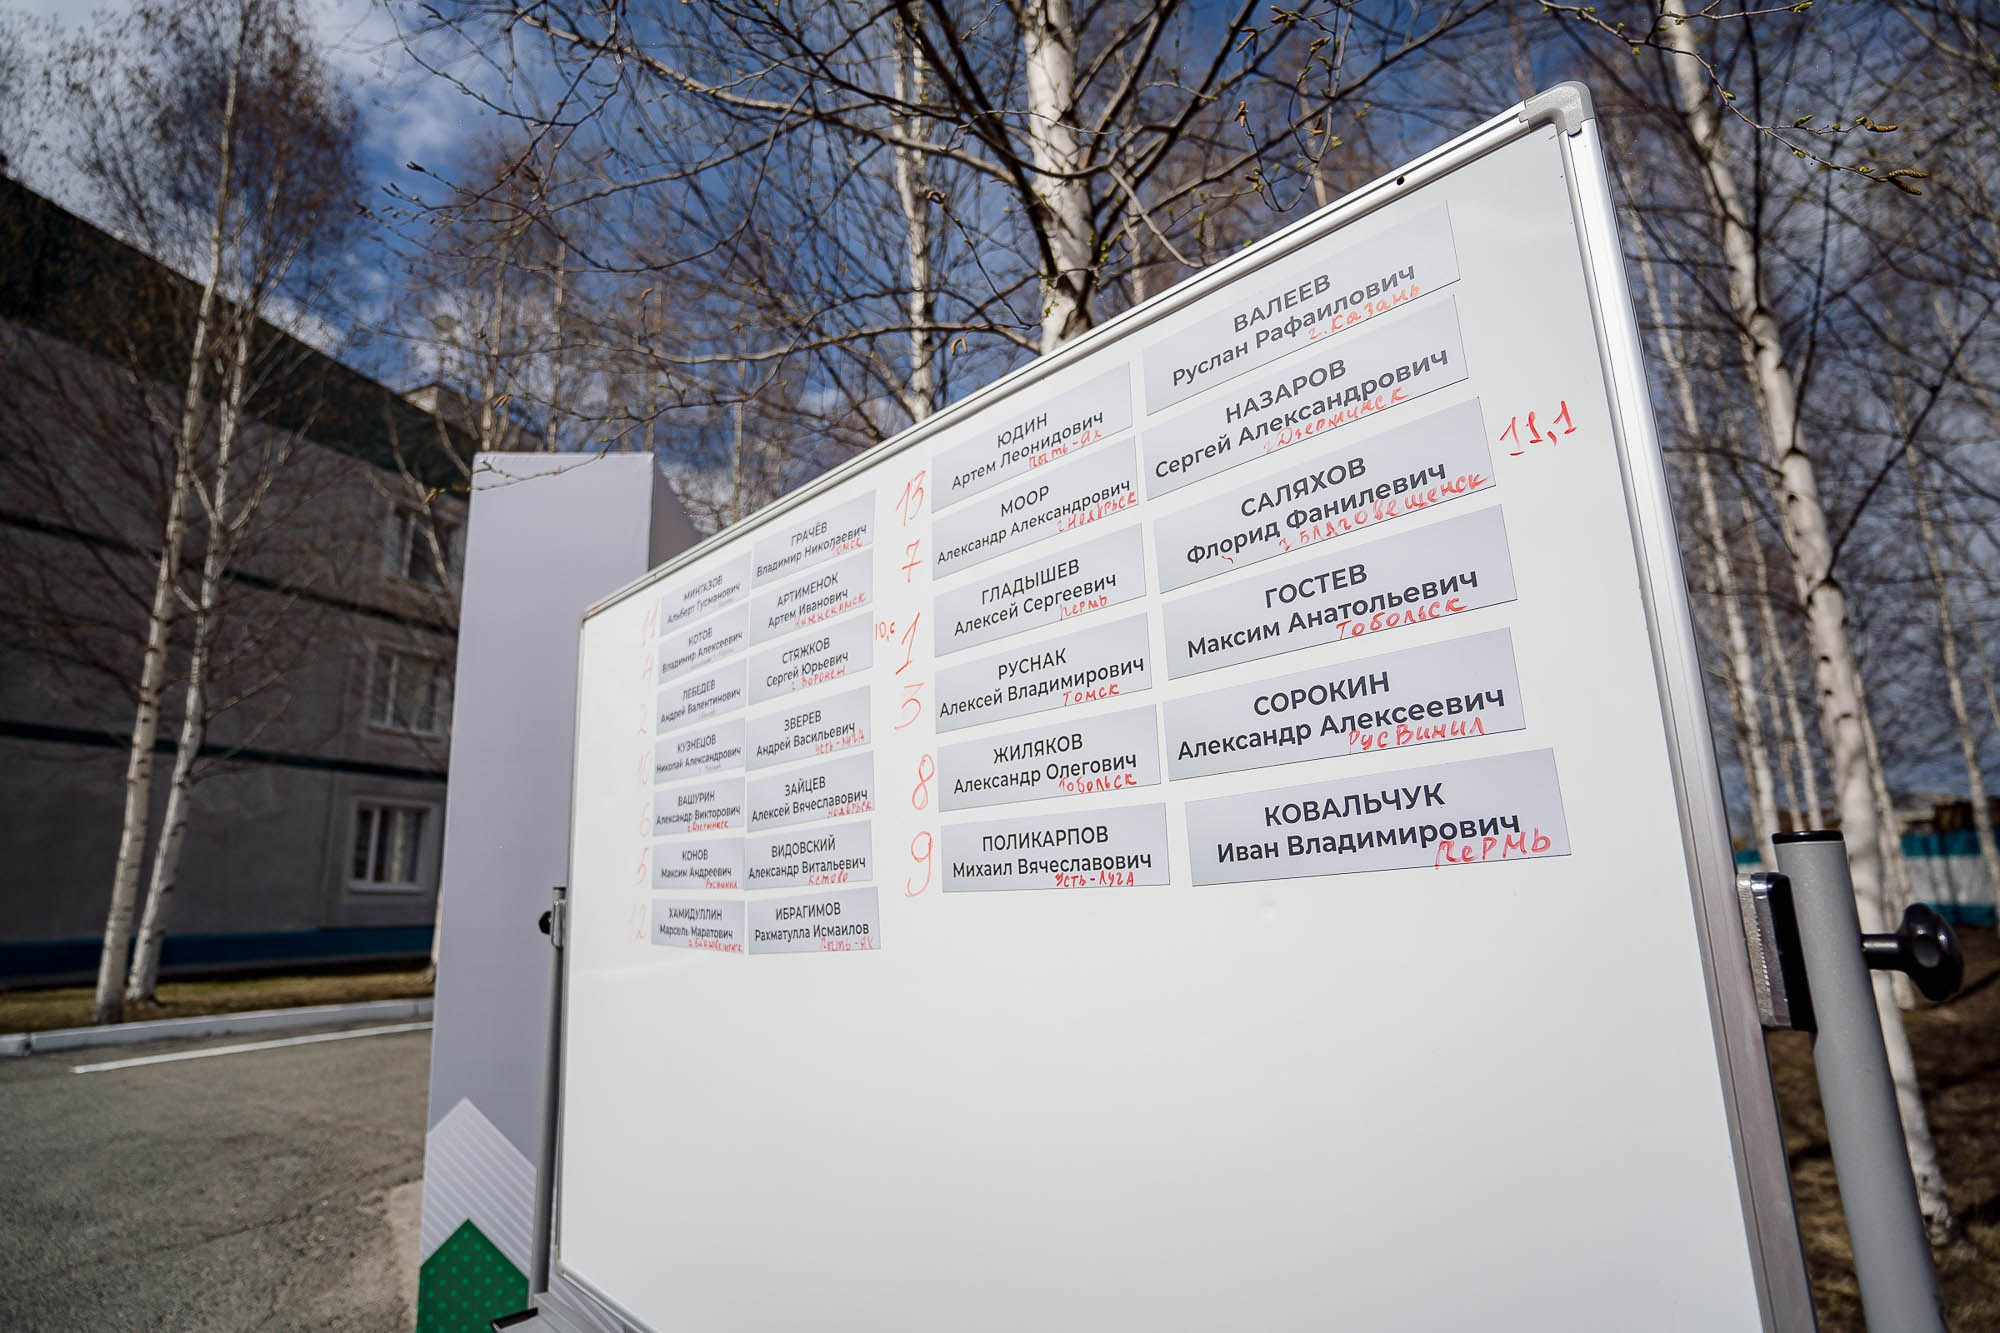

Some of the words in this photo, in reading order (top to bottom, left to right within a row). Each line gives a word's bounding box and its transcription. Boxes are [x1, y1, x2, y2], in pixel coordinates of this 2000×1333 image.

[1233, 274, 1331, 332] ВАЛЕЕВ
[1172, 341, 1248, 386] Руслан
[1255, 265, 1416, 348] Рафаилович
[1225, 358, 1347, 424] НАЗАРОВ
[997, 413, 1048, 448] ЮДИН
[1155, 436, 1231, 479] Сергей
[1238, 349, 1449, 446] Александрович
[952, 461, 996, 490] Артем
[1001, 412, 1103, 467] Леонидович
[896, 470, 927, 527] 13
[1001, 485, 1049, 517] МООР
[1240, 457, 1366, 518] САЛЯХОВ
[937, 529, 1007, 564] Александр
[1010, 480, 1130, 536] Александрович
[1187, 522, 1280, 564] Флорид
[1286, 463, 1446, 529] Фанилевич
[756, 550, 802, 577] Владимир
[804, 524, 867, 557] Николаевич
[791, 522, 828, 546] ГРАЧЁВ
[901, 539, 923, 583] 7
[683, 574, 723, 601] МИНГАЗОВ
[777, 571, 839, 608] АРТИМЕНОК
[981, 558, 1080, 605] ГЛАДЫШЕВ
[1265, 563, 1368, 609] ГОСТЕВ
[667, 605, 695, 624] Альберт
[768, 609, 797, 629] Артем
[799, 589, 848, 617] Иванович
[954, 603, 1018, 636] Алексей
[1023, 573, 1116, 614] Сергеевич
[1188, 621, 1281, 658] Максим
[1288, 570, 1478, 634] Анатольевич
[662, 653, 696, 674] Владимир
[697, 631, 743, 657] Алексеевич
[688, 627, 713, 647] КОТОВ
[782, 637, 830, 664] СТЯЖКОВ
[895, 611, 921, 675] 1
[766, 665, 799, 688] Сергей
[801, 652, 848, 679] Юрьевич
[998, 648, 1067, 680] РУСНАК
[661, 706, 686, 724] Андрей
[687, 688, 741, 713] Валентинович
[683, 679, 716, 701] ЛЕБЕДЕВ
[894, 682, 925, 730] 3
[940, 688, 1003, 718] Алексей
[1008, 658, 1145, 701] Владимирович
[1254, 671, 1390, 717] СОРОКИН
[784, 710, 822, 731] ЗВЕРЕВ
[1178, 720, 1313, 761] Александр
[1320, 689, 1505, 734] Алексеевич
[677, 734, 717, 752] КУЗНЕЦОВ
[756, 735, 791, 757] Андрей
[793, 722, 855, 748] Васильевич
[993, 733, 1083, 764] ЖИЛЯКОВ
[656, 759, 683, 774] Николай
[685, 746, 741, 768] Александрович
[954, 768, 1041, 794] Александр
[1046, 754, 1137, 779] Олегович
[677, 790, 715, 807] ВАШУРИН
[784, 776, 826, 797] ЗАЙЦЕВ
[911, 753, 935, 811] 8
[656, 811, 693, 826] Александр
[694, 805, 740, 821] Викторович
[752, 802, 790, 822] Алексей
[793, 789, 868, 815] Вячеславович
[1265, 782, 1445, 827] КОВАЛЬЧУК
[682, 849, 709, 861] КОНОВ
[771, 834, 836, 858] ВИДОВСКИЙ
[982, 826, 1109, 852] ПОЛИКАРПОВ
[1217, 839, 1280, 864] Иван
[1288, 815, 1521, 857] Владимирович
[661, 868, 687, 879] Максим
[689, 867, 732, 880] Андреевич
[749, 861, 799, 880] Александр
[802, 856, 866, 874] Витальевич
[904, 831, 933, 897] 9
[953, 860, 1012, 878] Михаил
[1018, 854, 1152, 875] Вячеславович
[669, 908, 723, 921] ХАМИДУЛЛИН
[776, 902, 841, 921] ИБРАГИМОВ
[660, 924, 689, 937] Марсель
[691, 926, 733, 940] Маратович
[755, 927, 811, 942] Рахматулла
[813, 923, 870, 939] Исмаилов
